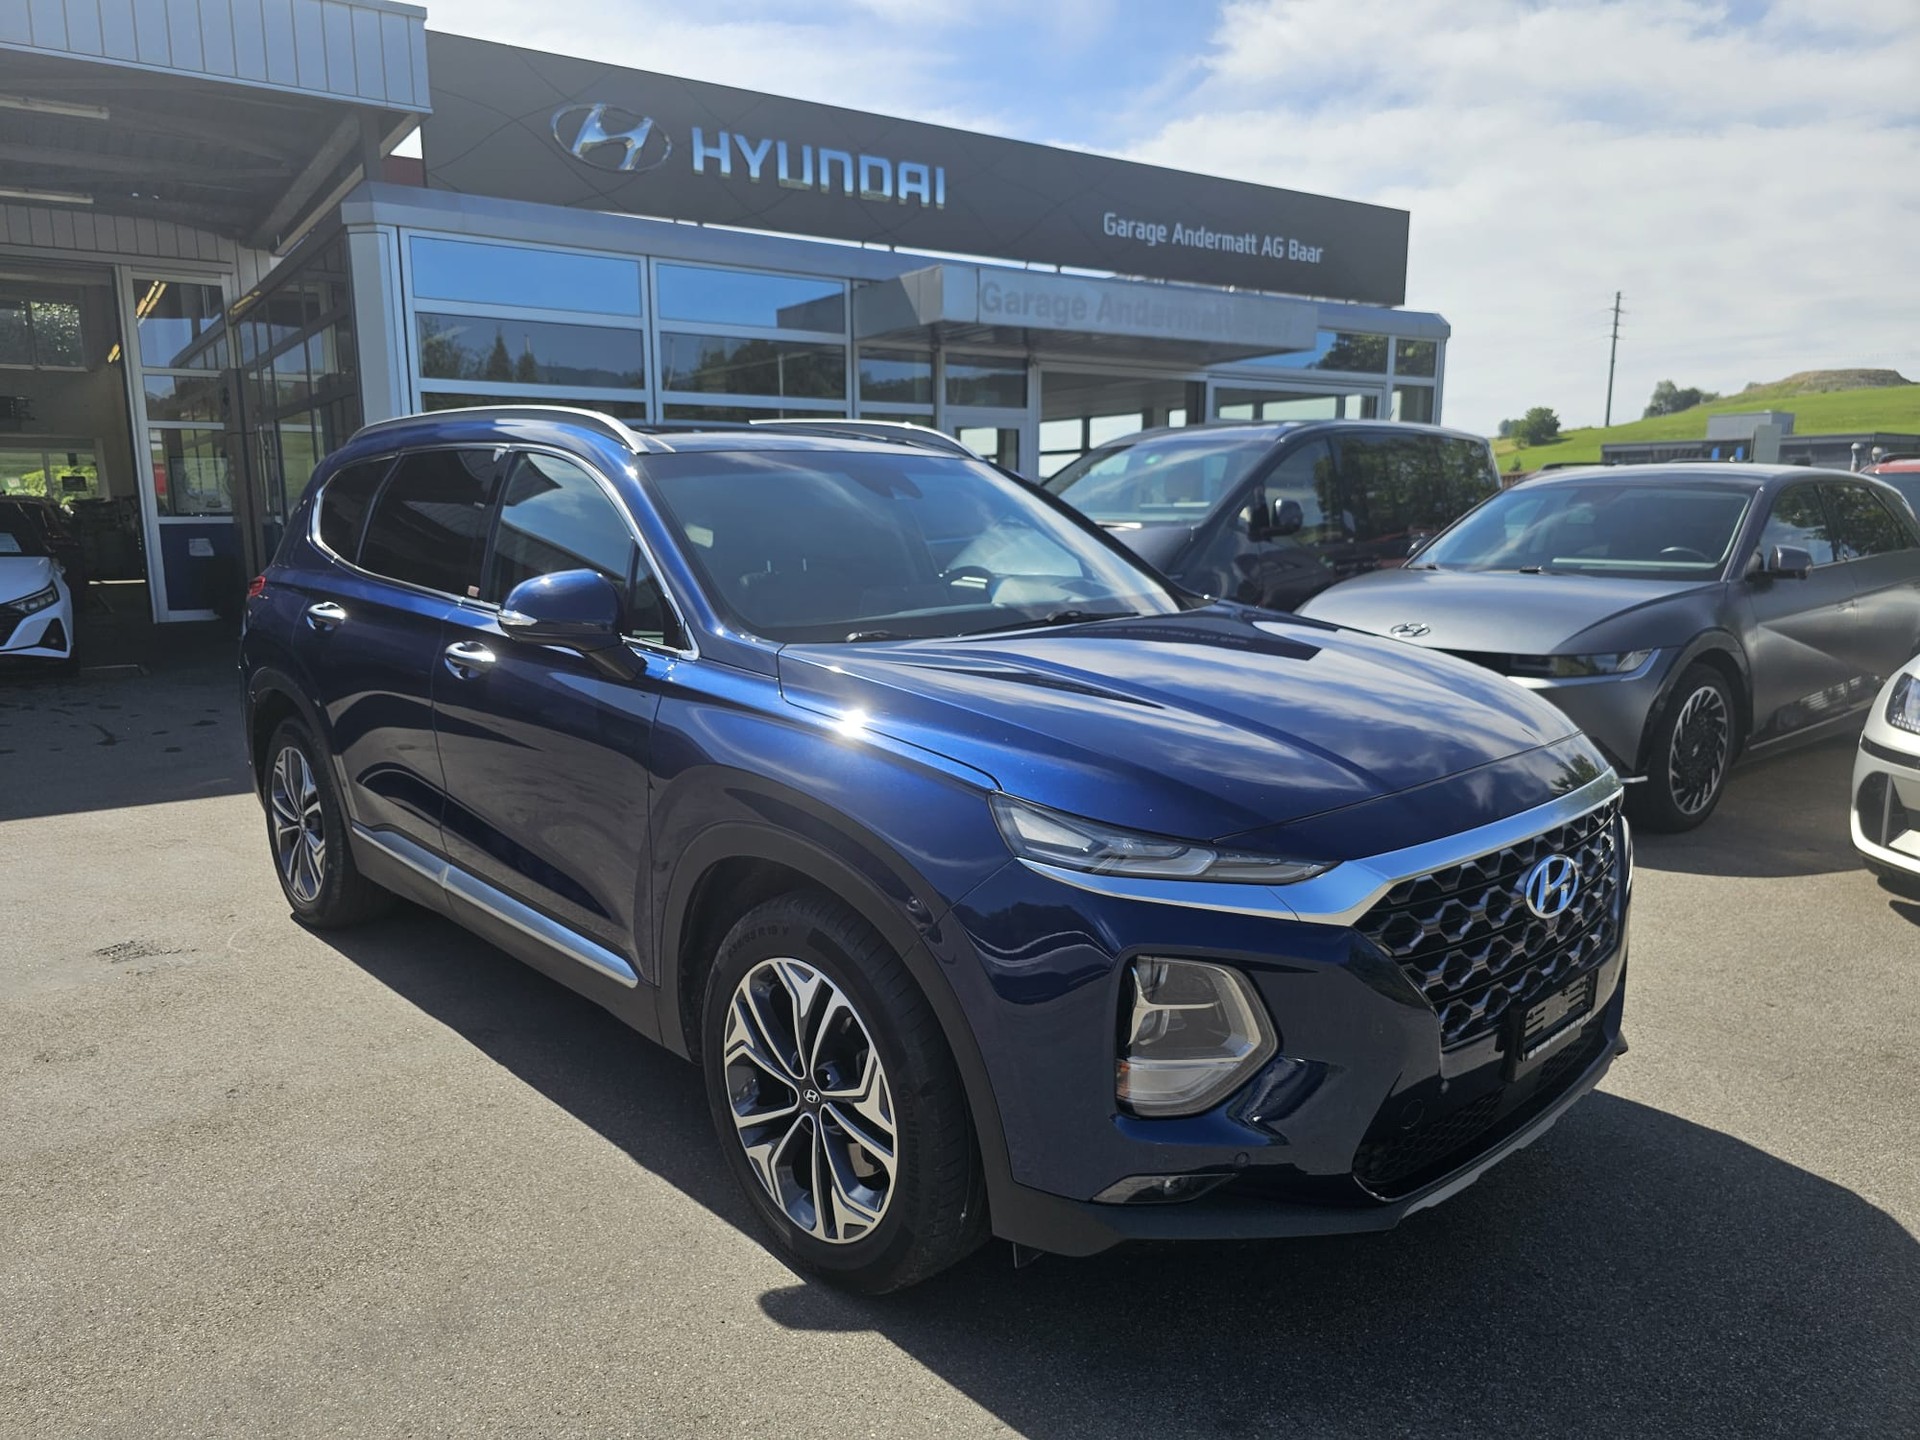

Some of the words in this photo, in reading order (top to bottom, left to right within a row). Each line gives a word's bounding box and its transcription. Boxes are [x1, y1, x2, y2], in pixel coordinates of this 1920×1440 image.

[691, 126, 946, 210] HYUNDAI
[1102, 212, 1167, 247] Garage
[1171, 222, 1258, 256] Andermatt
[1261, 235, 1284, 259] AG
[1288, 239, 1324, 264] Baar
[980, 282, 1088, 327] Garage
